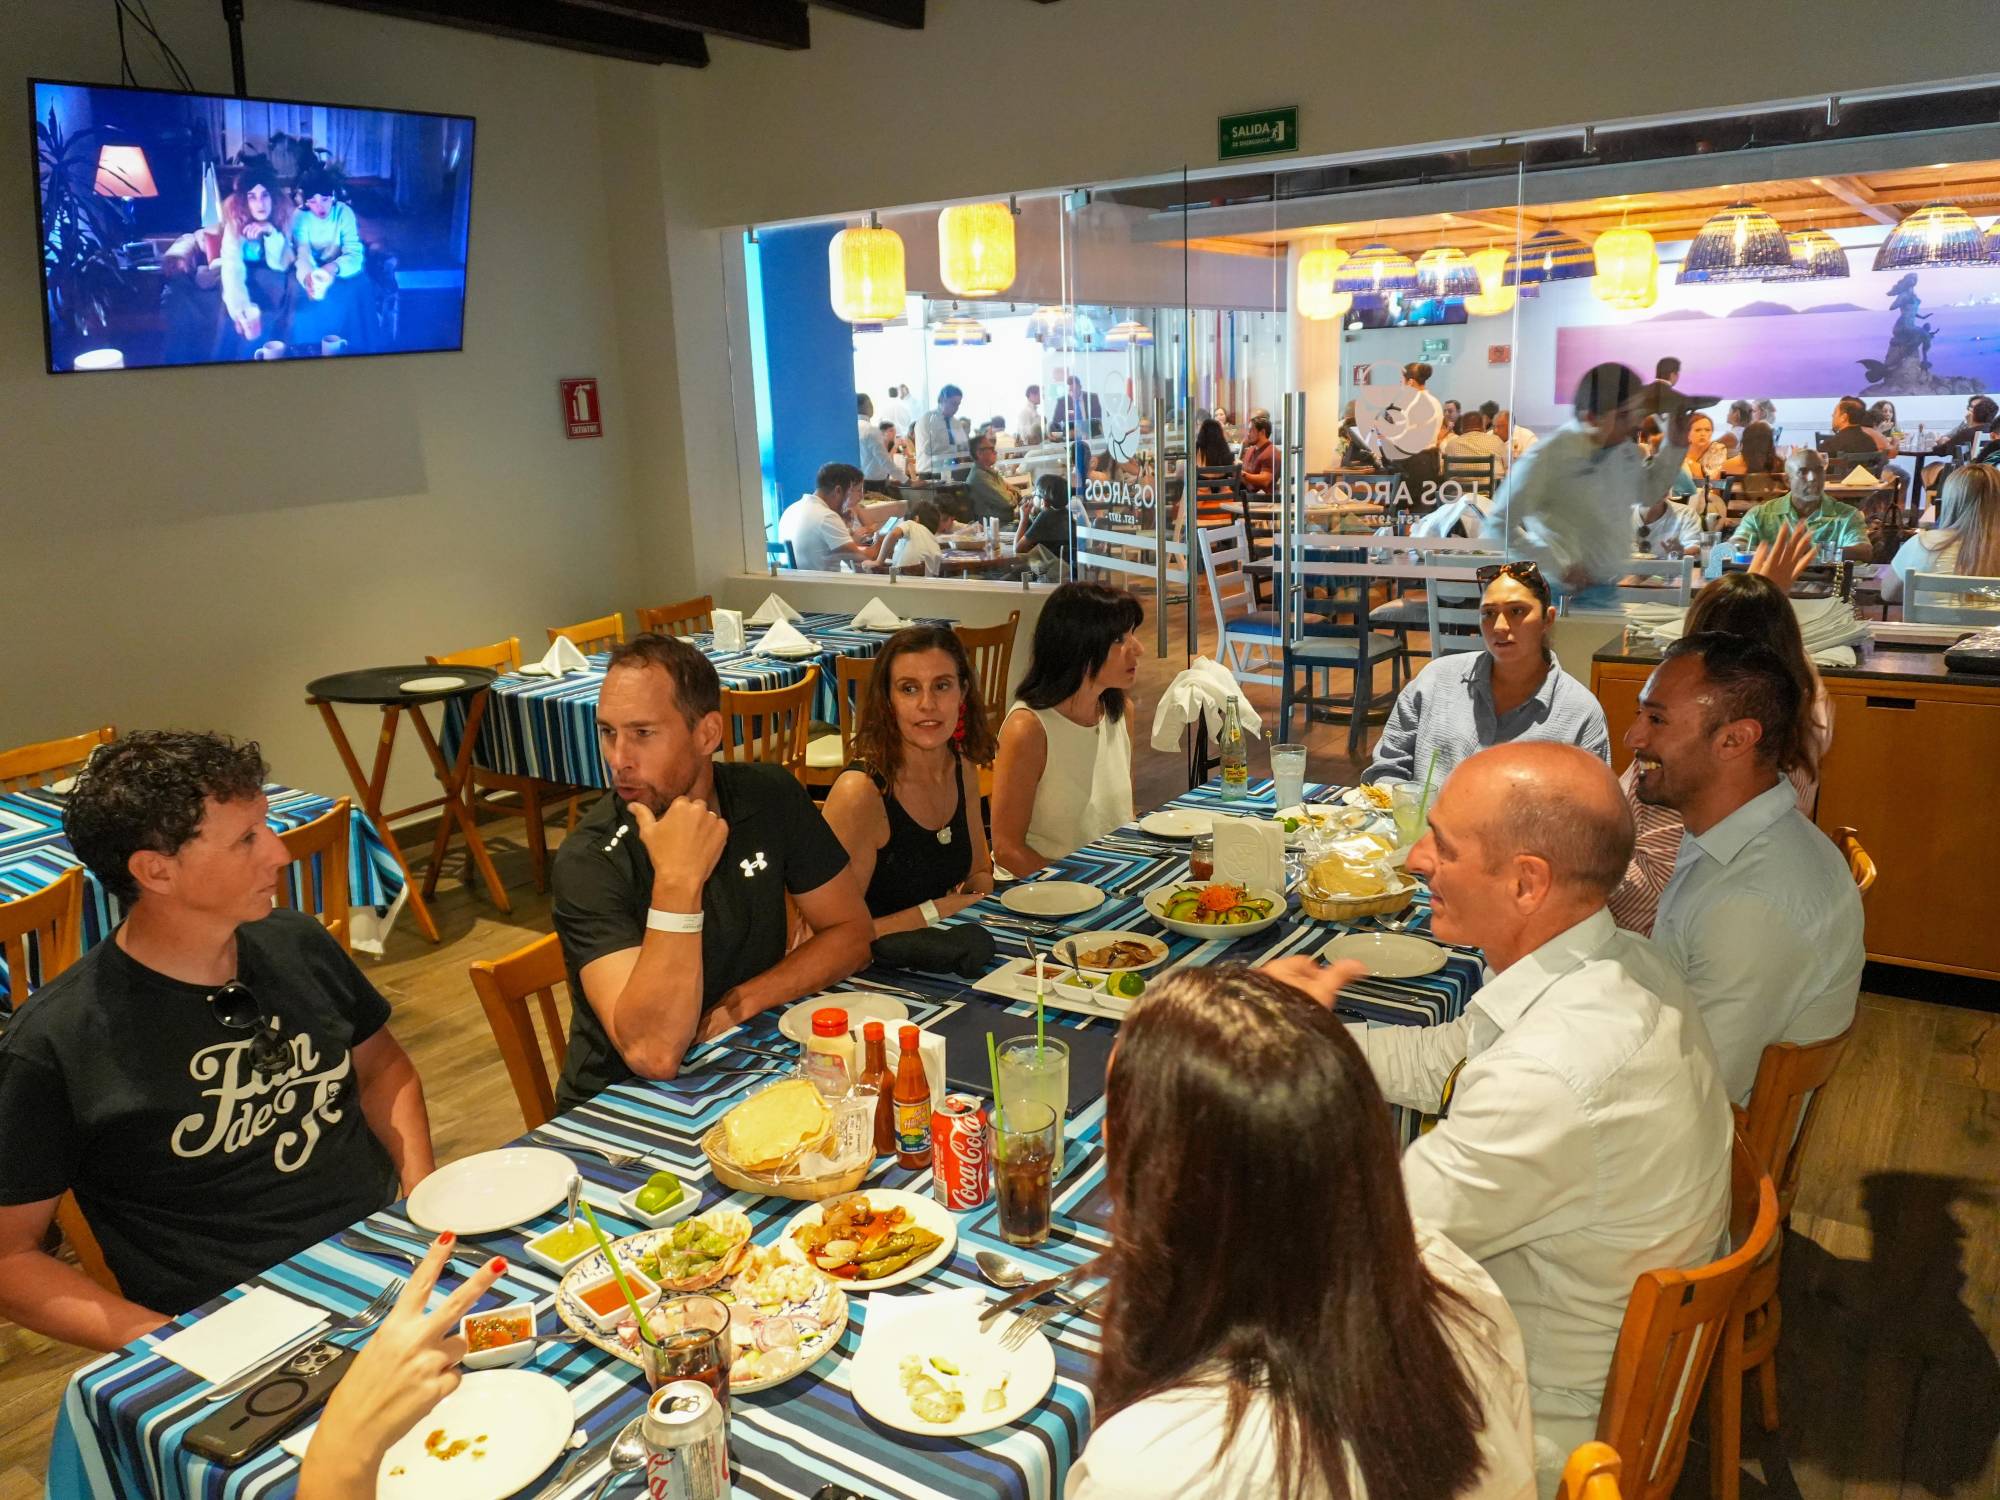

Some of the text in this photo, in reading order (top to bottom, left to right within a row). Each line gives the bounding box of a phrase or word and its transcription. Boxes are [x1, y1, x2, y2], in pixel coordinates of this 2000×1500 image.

[1232, 122, 1270, 138] SALIDA
[223, 1102, 277, 1154] de
[949, 1112, 983, 1210] Coca-Cola
